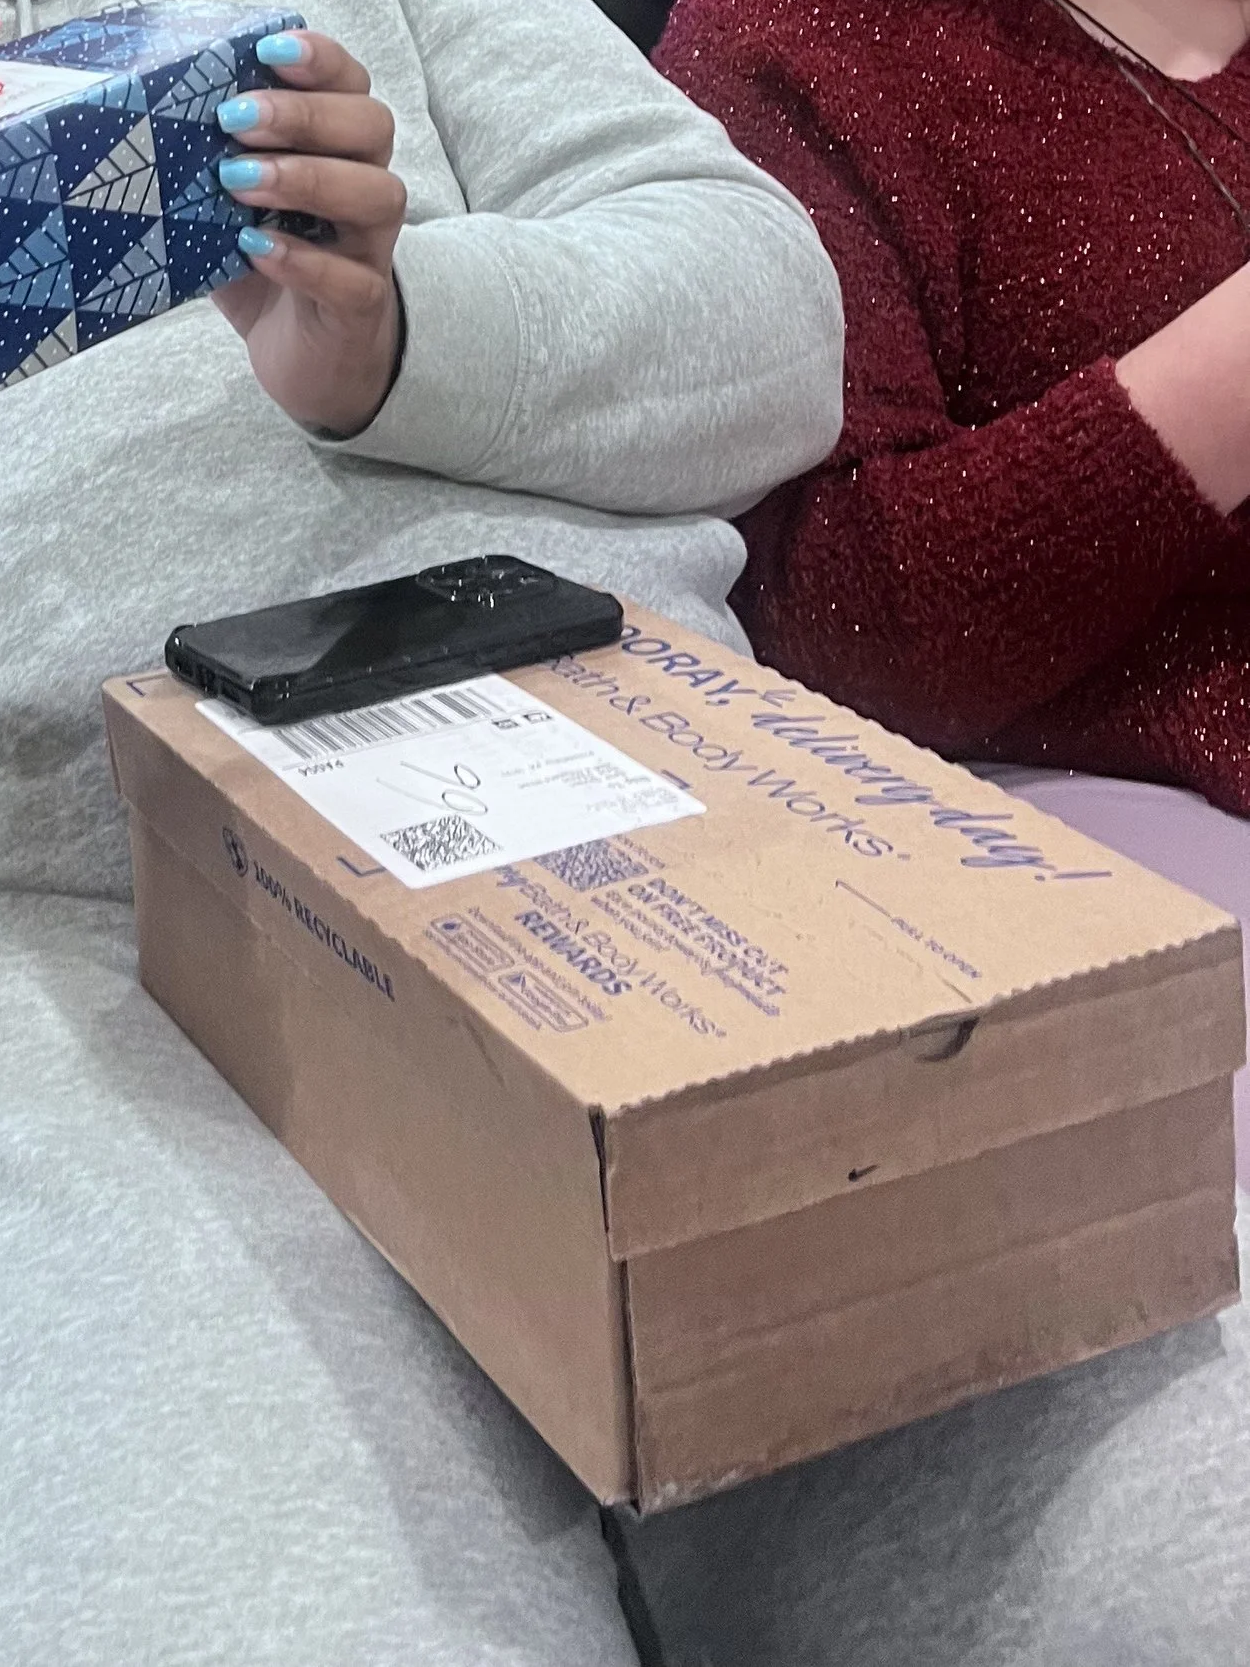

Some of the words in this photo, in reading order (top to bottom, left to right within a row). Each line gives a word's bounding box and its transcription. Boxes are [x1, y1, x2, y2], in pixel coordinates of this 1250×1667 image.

[609, 694, 650, 715] &
[639, 711, 758, 772] Body
[293, 897, 395, 1002] RECYCLABLE
[515, 910, 633, 995] REWARDS
